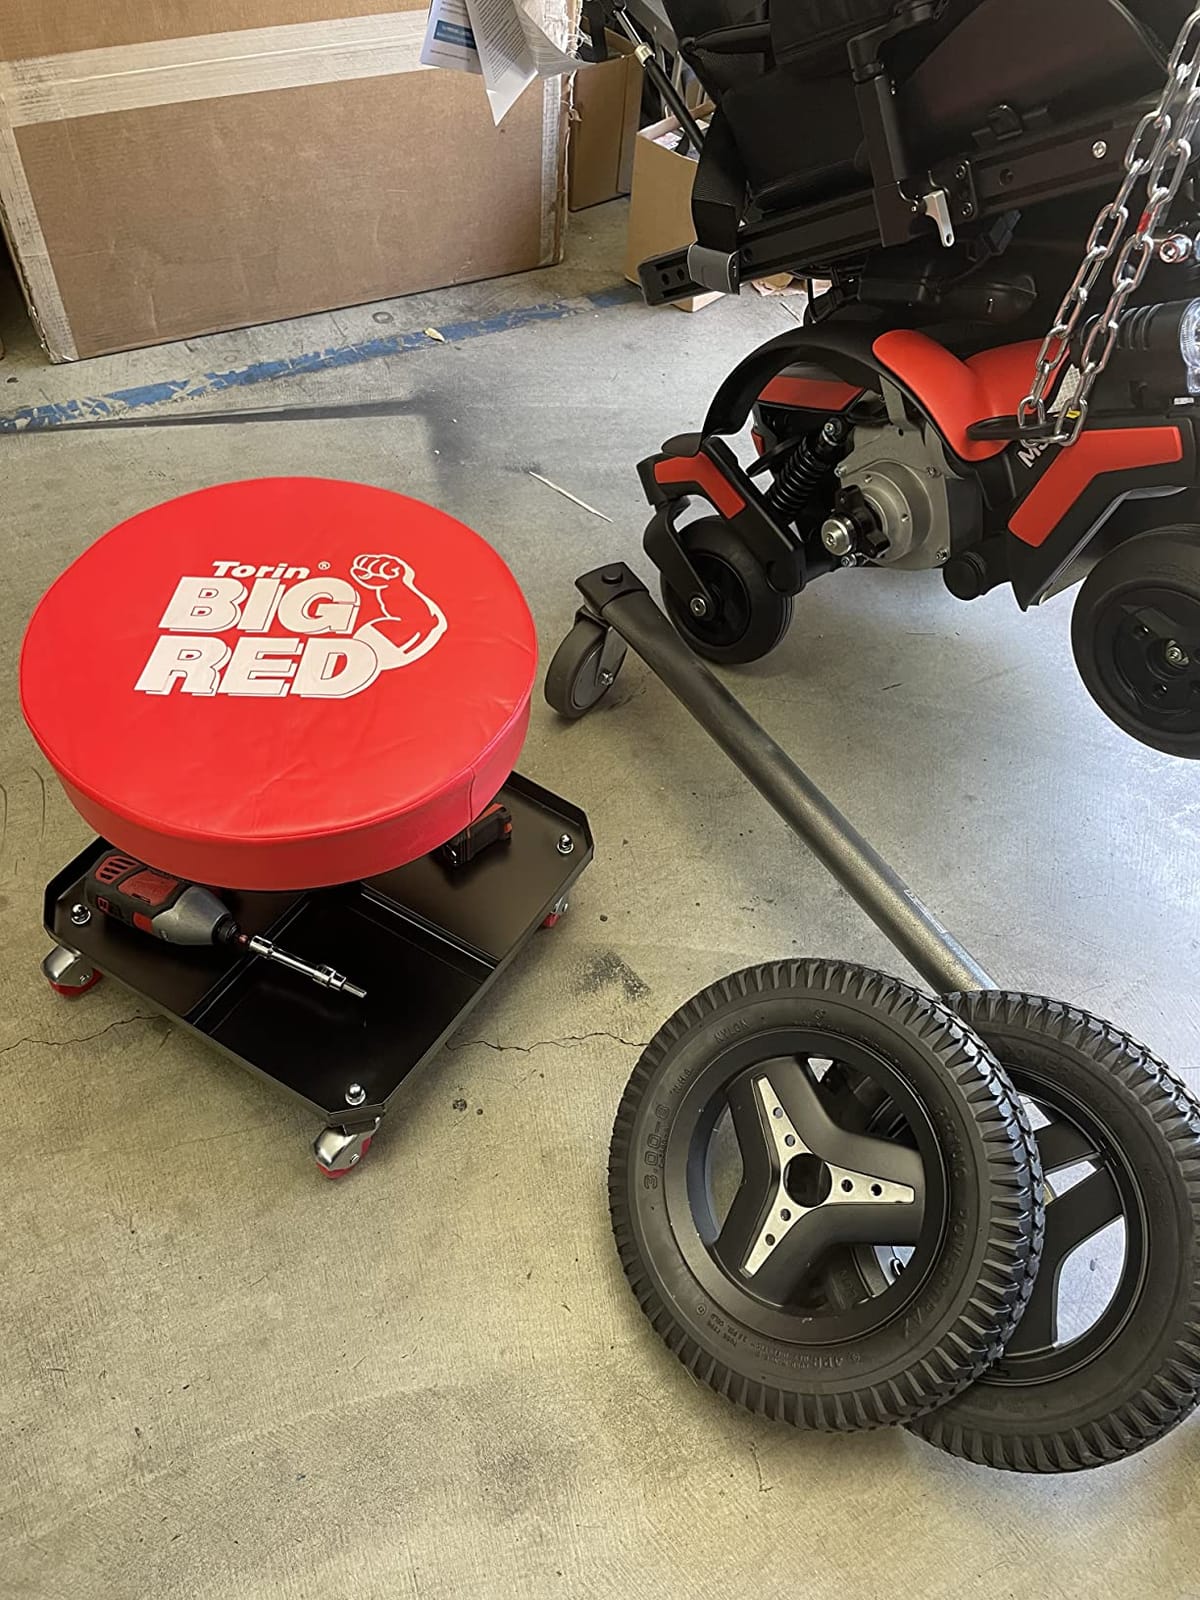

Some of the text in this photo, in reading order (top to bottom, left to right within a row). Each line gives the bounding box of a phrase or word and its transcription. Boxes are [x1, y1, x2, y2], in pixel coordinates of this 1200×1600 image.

[211, 561, 310, 579] Torin
[158, 576, 361, 634] BIG
[134, 635, 379, 699] RED
[643, 1103, 670, 1190] 3.00-8
